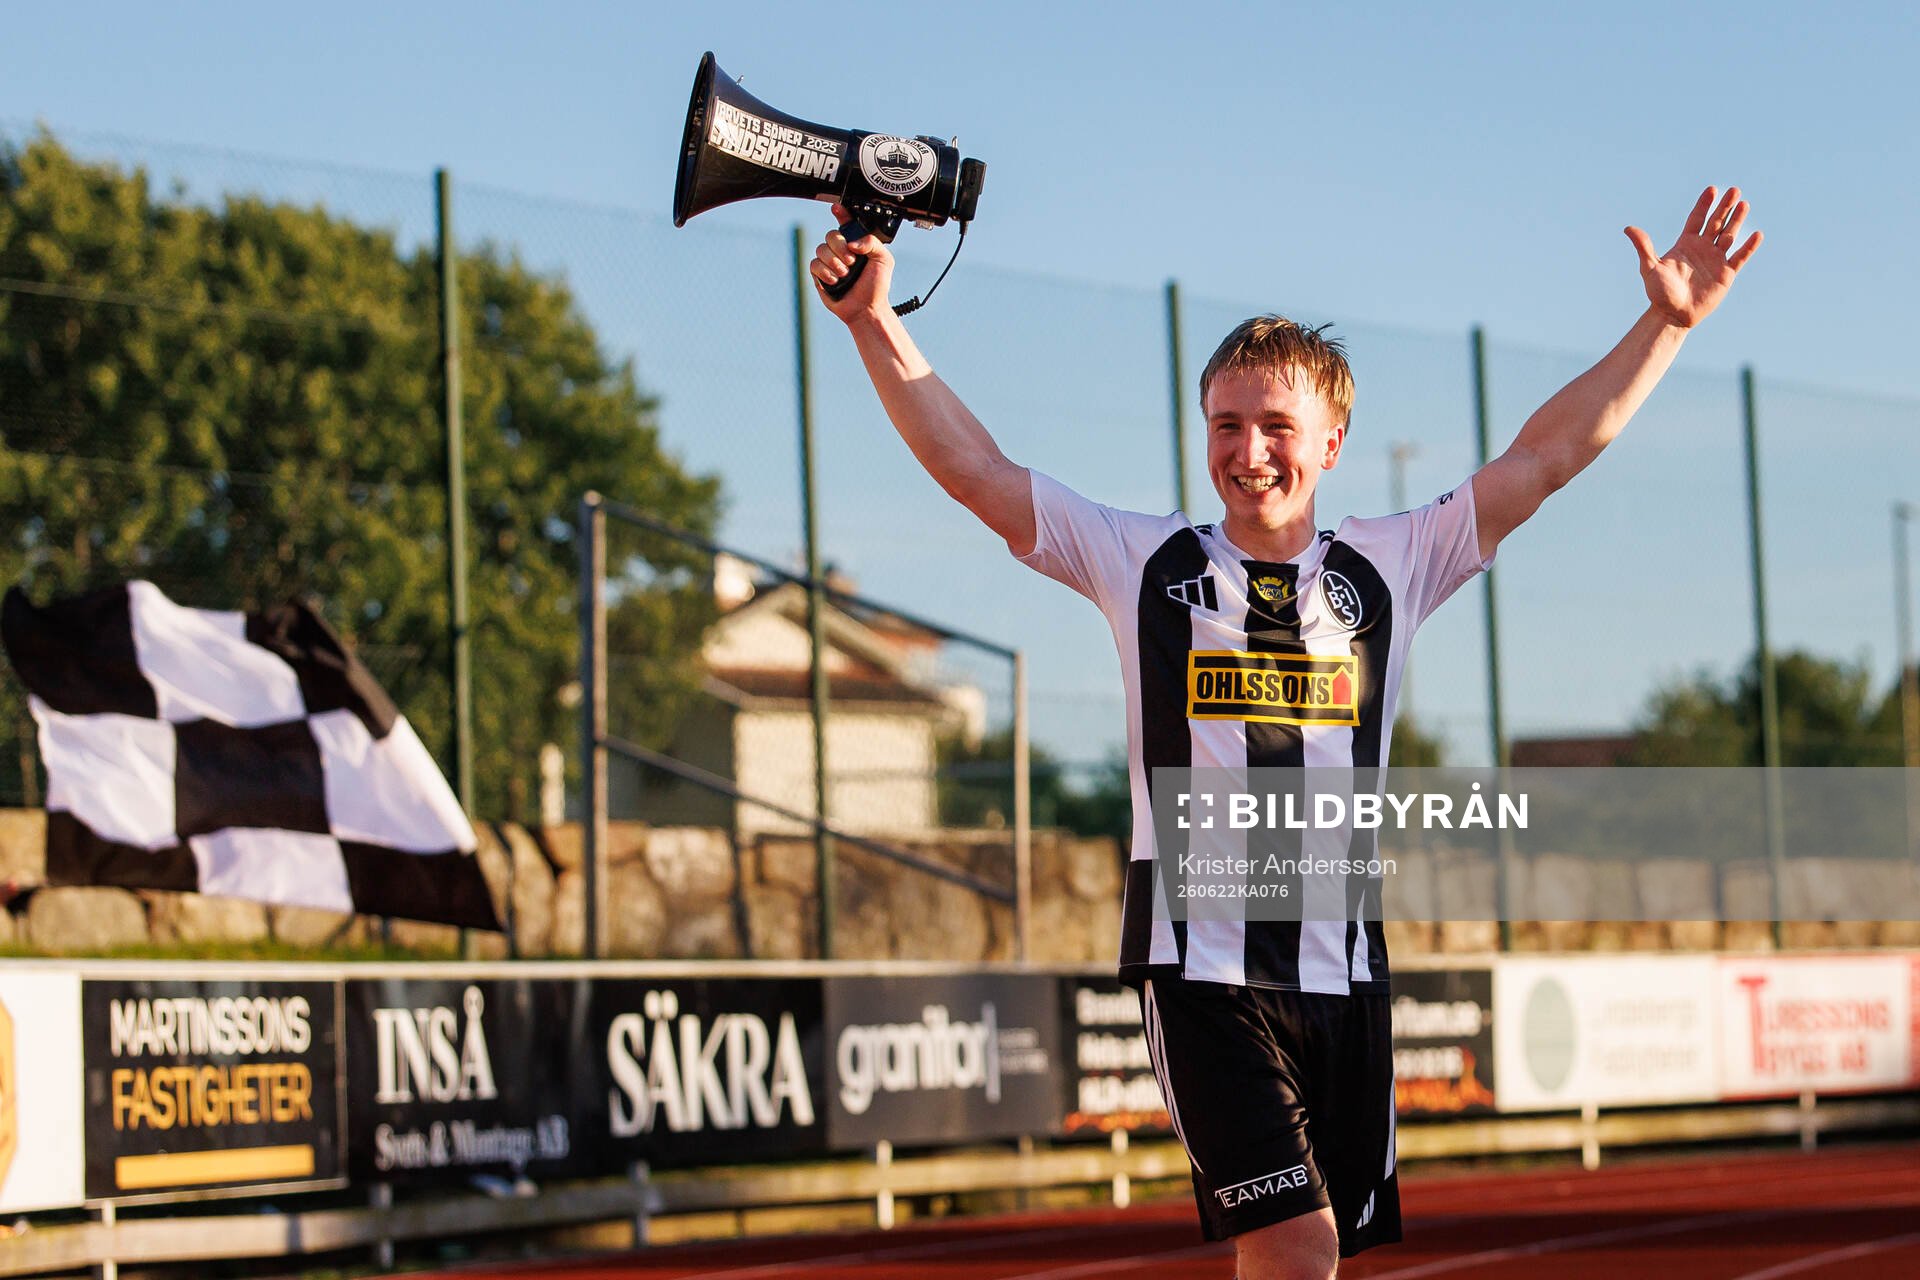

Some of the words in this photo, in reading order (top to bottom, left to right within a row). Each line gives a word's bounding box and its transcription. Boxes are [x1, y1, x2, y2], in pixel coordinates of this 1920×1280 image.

[870, 172, 923, 192] LANDSKRONA
[1196, 671, 1329, 705] OHLSSONS
[110, 996, 312, 1057] MARTINSSONS
[373, 984, 497, 1105] INSÅ
[607, 989, 814, 1138] SÄKRA
[111, 1063, 313, 1131] FASTIGHETER
